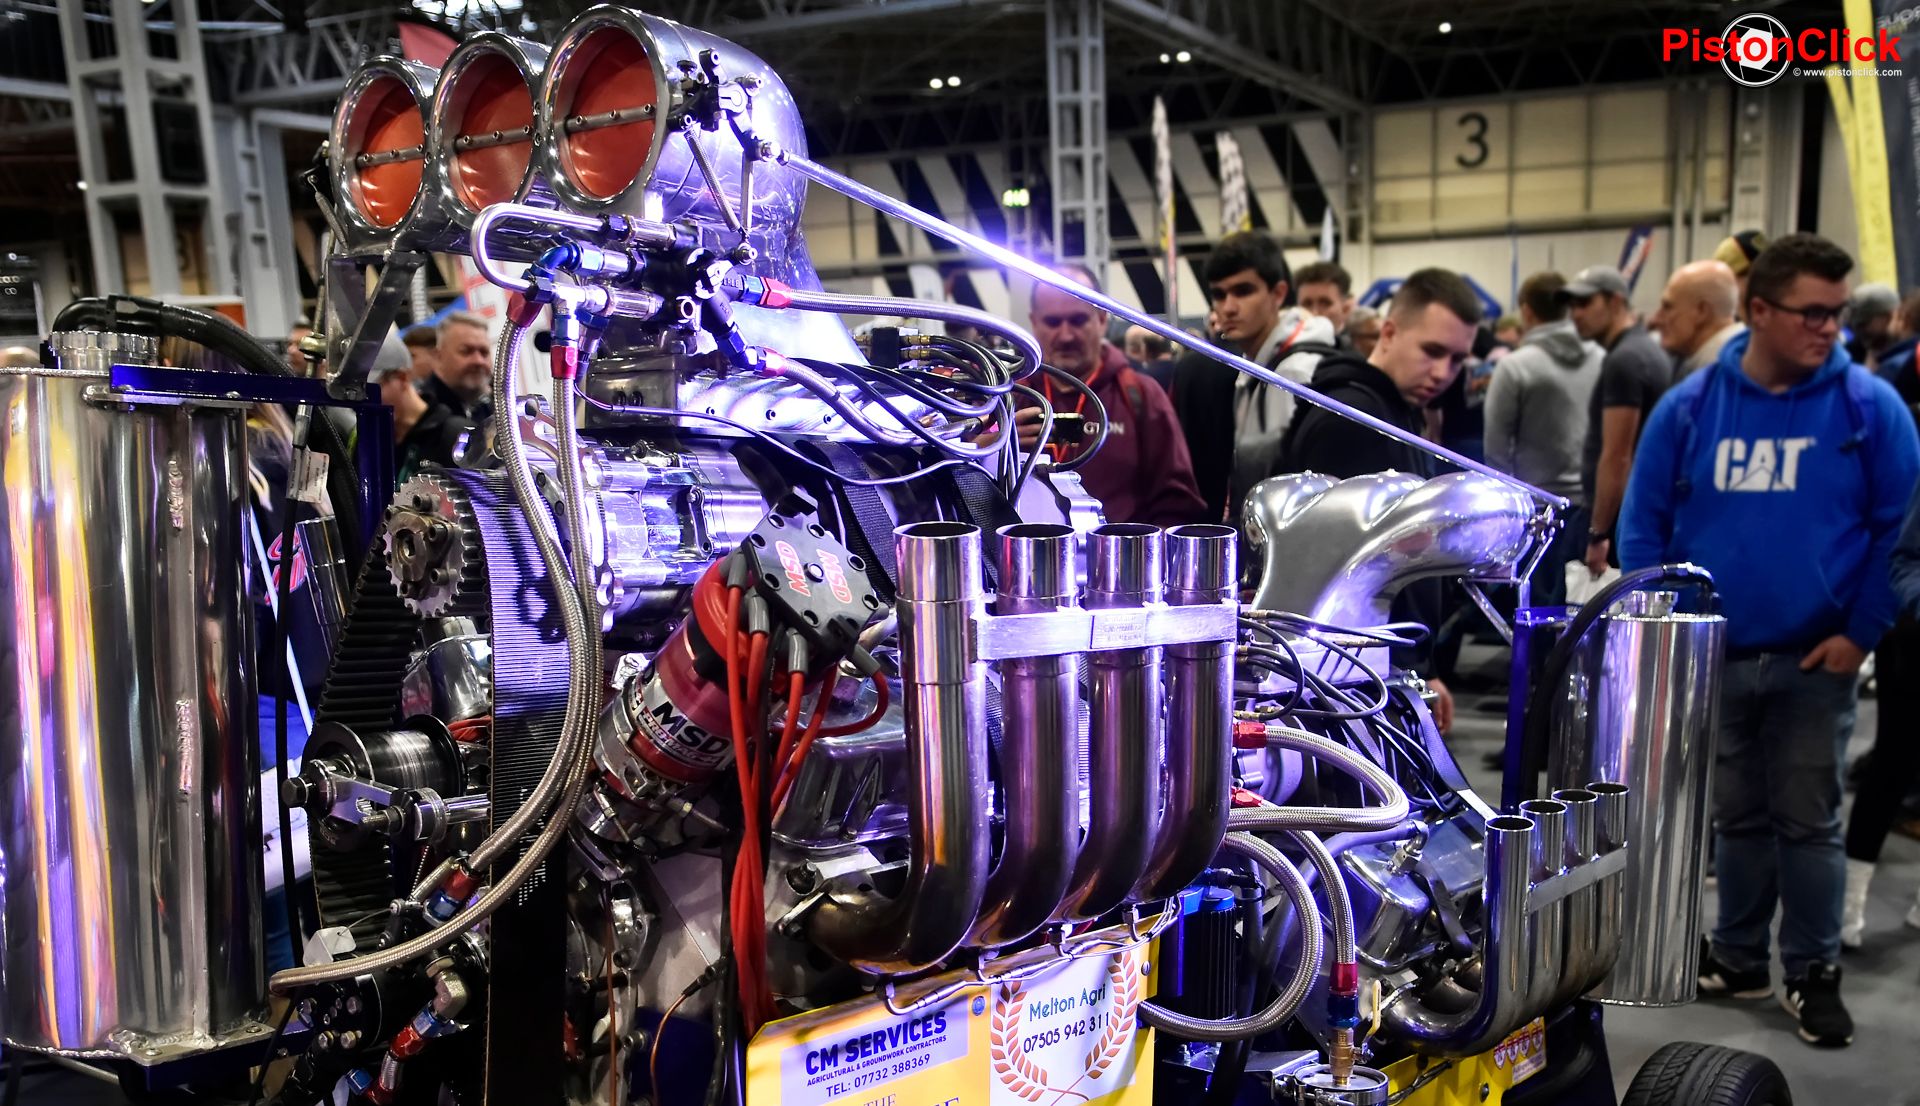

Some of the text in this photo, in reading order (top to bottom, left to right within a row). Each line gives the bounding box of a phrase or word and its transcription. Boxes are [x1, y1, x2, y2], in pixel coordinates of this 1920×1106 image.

[1456, 112, 1488, 168] 3
[1714, 438, 1809, 492] CAT
[775, 540, 812, 597] MSD
[816, 548, 852, 604] MSD
[651, 700, 730, 755] MSD
[1029, 983, 1106, 1022] Melton Agri
[805, 1010, 947, 1076] CM SERVICES
[807, 1066, 855, 1087] AGRICULTURAL
[862, 1050, 905, 1068] GROUNDWORK
[905, 1035, 947, 1054] CONTRACTORS
[1023, 1028, 1061, 1053] 07505
[1064, 1020, 1086, 1040] 942
[826, 1053, 931, 1098] TEL: 07732 388369
